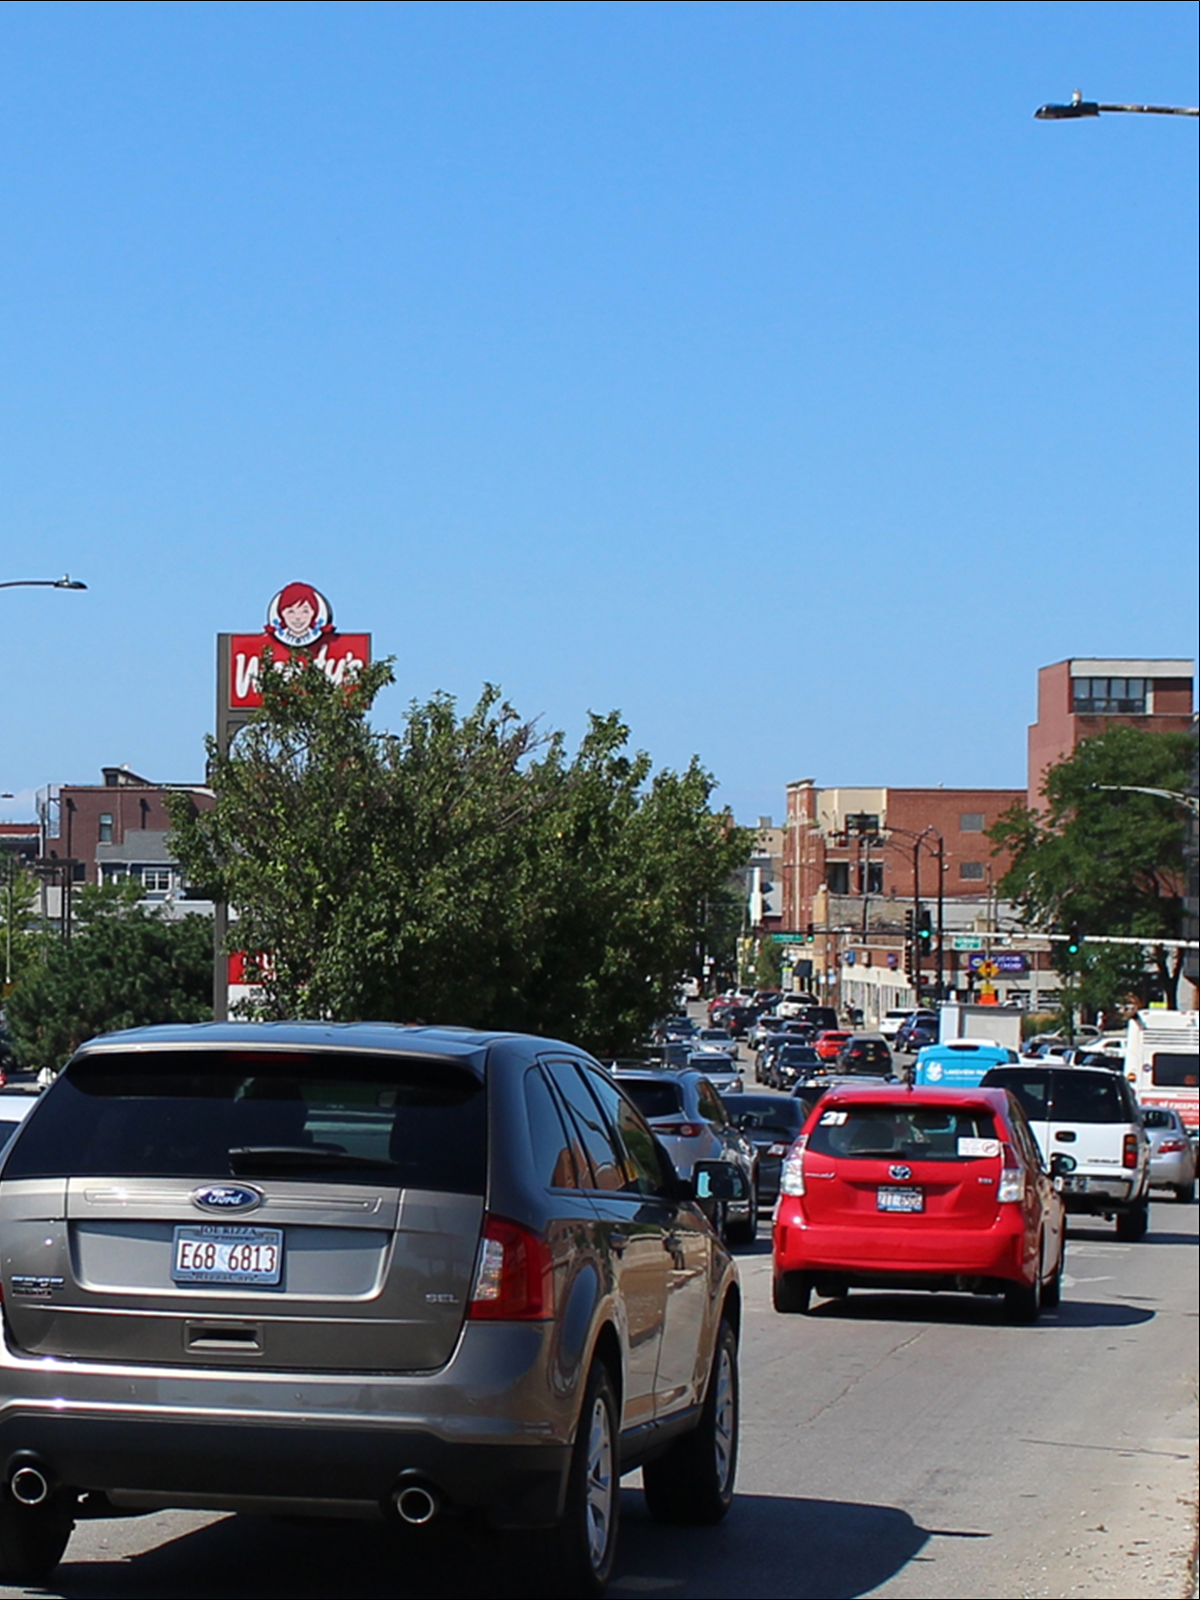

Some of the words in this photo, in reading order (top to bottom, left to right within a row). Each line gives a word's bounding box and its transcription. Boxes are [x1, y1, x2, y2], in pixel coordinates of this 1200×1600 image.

[820, 1111, 848, 1125] 21
[180, 1243, 216, 1270] E68
[228, 1244, 276, 1273] 6813
